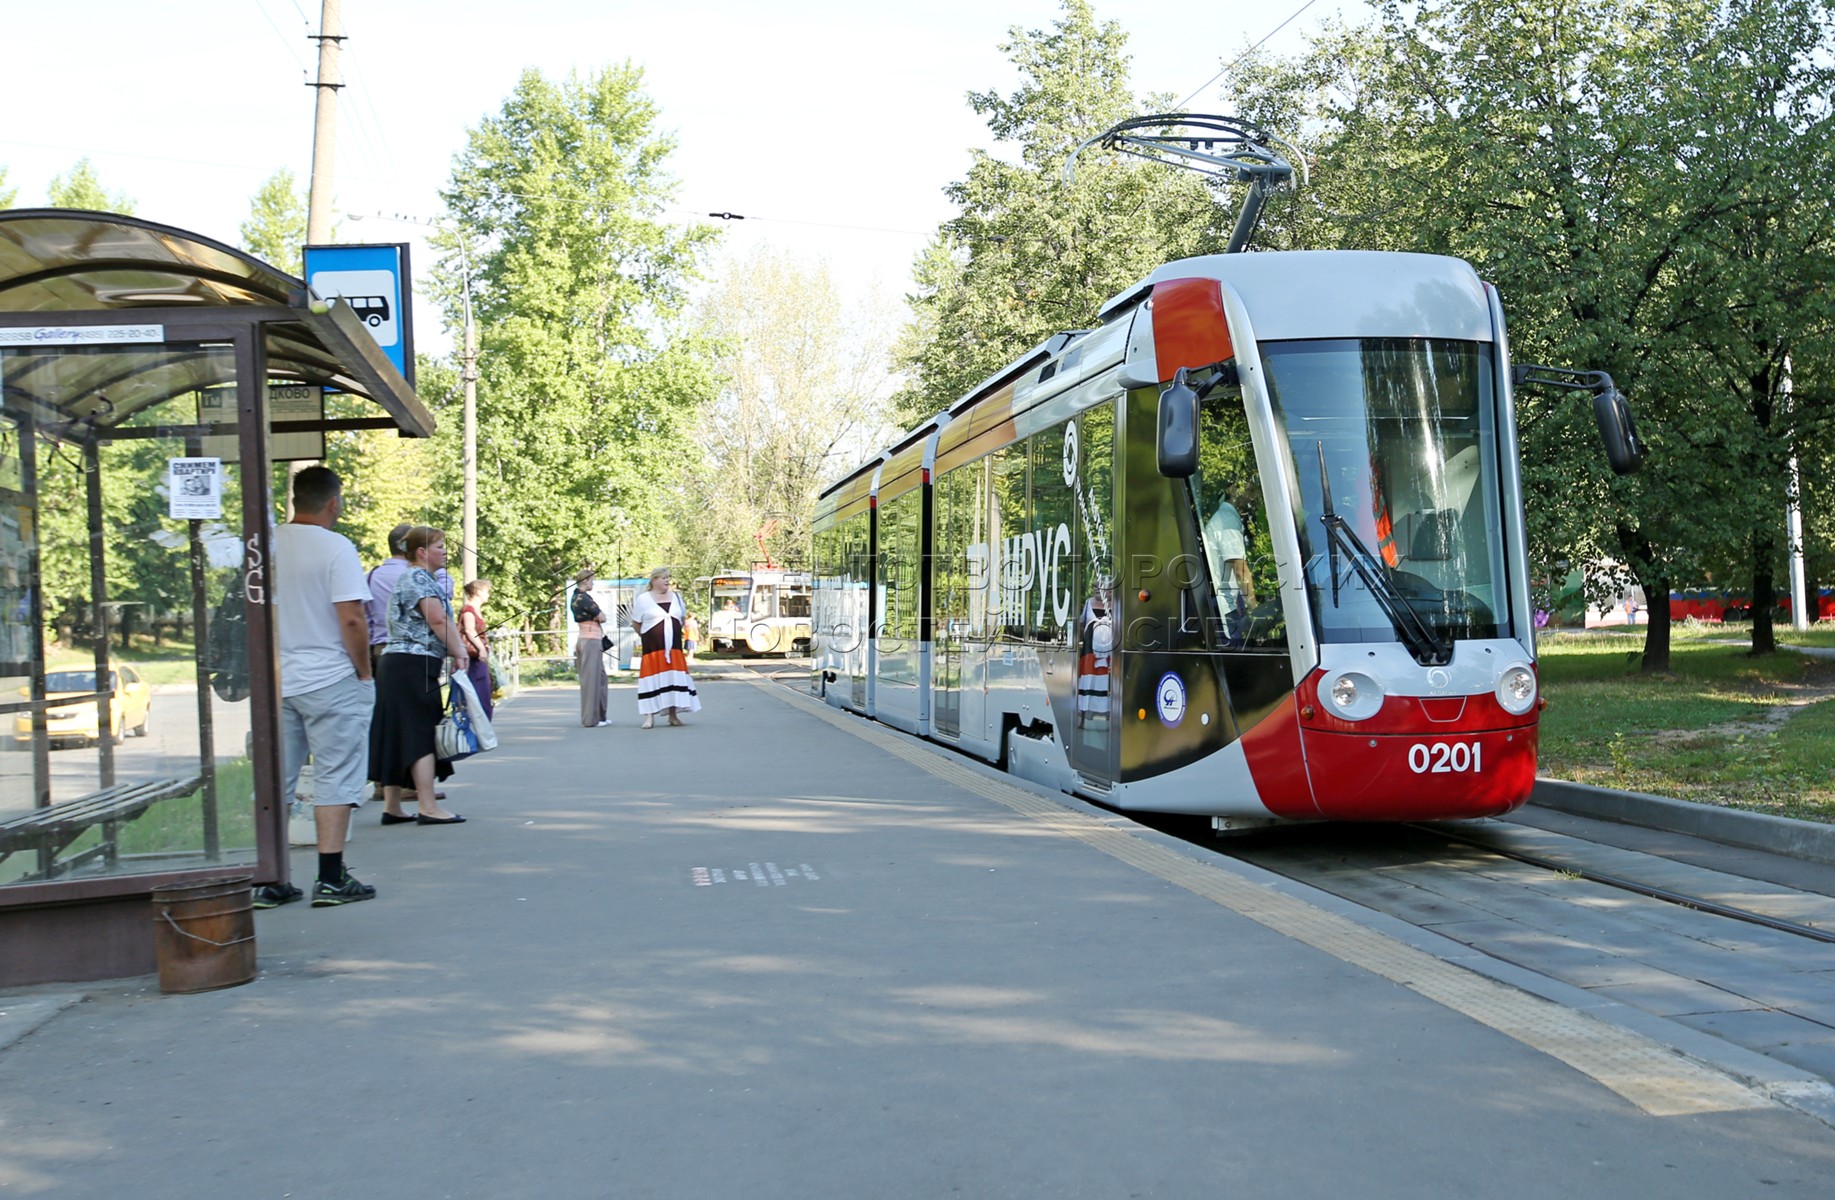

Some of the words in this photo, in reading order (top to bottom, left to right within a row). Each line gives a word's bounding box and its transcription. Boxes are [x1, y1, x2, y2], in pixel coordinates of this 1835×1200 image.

[34, 329, 81, 342] Gallery
[268, 388, 311, 400] ДКОВО
[1408, 742, 1481, 774] 0201
